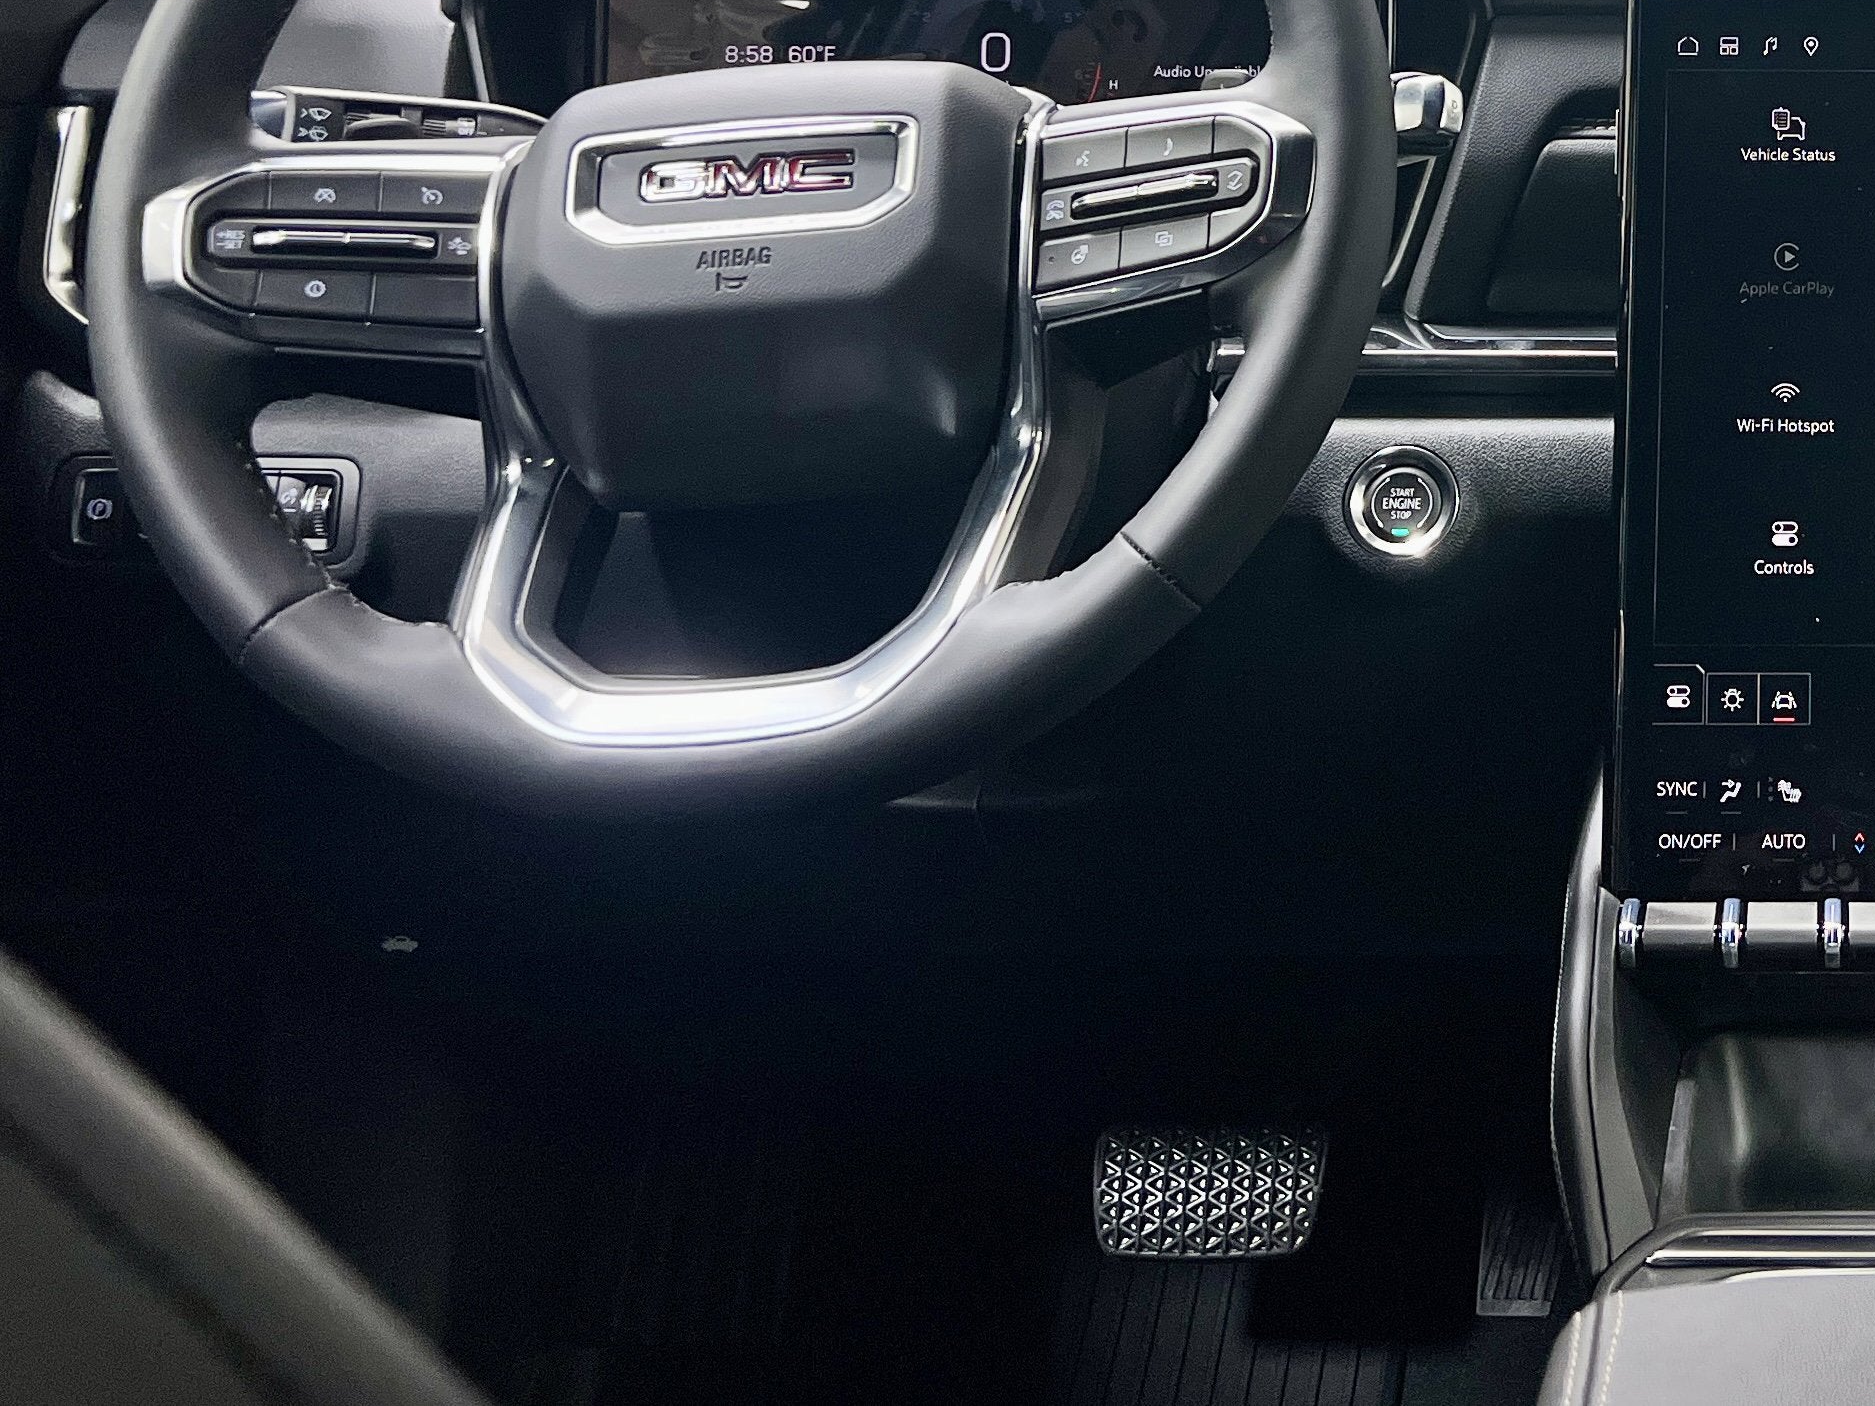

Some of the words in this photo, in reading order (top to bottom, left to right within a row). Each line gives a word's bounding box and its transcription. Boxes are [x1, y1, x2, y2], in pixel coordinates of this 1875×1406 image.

[725, 46, 773, 63] 8:58
[788, 45, 836, 62] 60°F
[1154, 66, 1191, 78] Audio
[1109, 80, 1118, 90] H
[1741, 148, 1789, 161] Vehicle
[1793, 148, 1835, 161] Status
[639, 149, 856, 203] GMC
[695, 245, 772, 270] AIRBAG
[1740, 282, 1775, 298] Apple
[1779, 282, 1835, 298] CarPlay
[1737, 418, 1773, 432] Wi-Fi
[1778, 419, 1834, 435] Hotspot
[1390, 488, 1414, 497] START
[1383, 498, 1421, 509] ENGINE
[1391, 511, 1412, 519] STOP
[1754, 559, 1814, 574] Controls
[1657, 781, 1697, 796] SYNC
[1658, 834, 1721, 851] ON/OFF
[1762, 834, 1805, 849] AUTO
